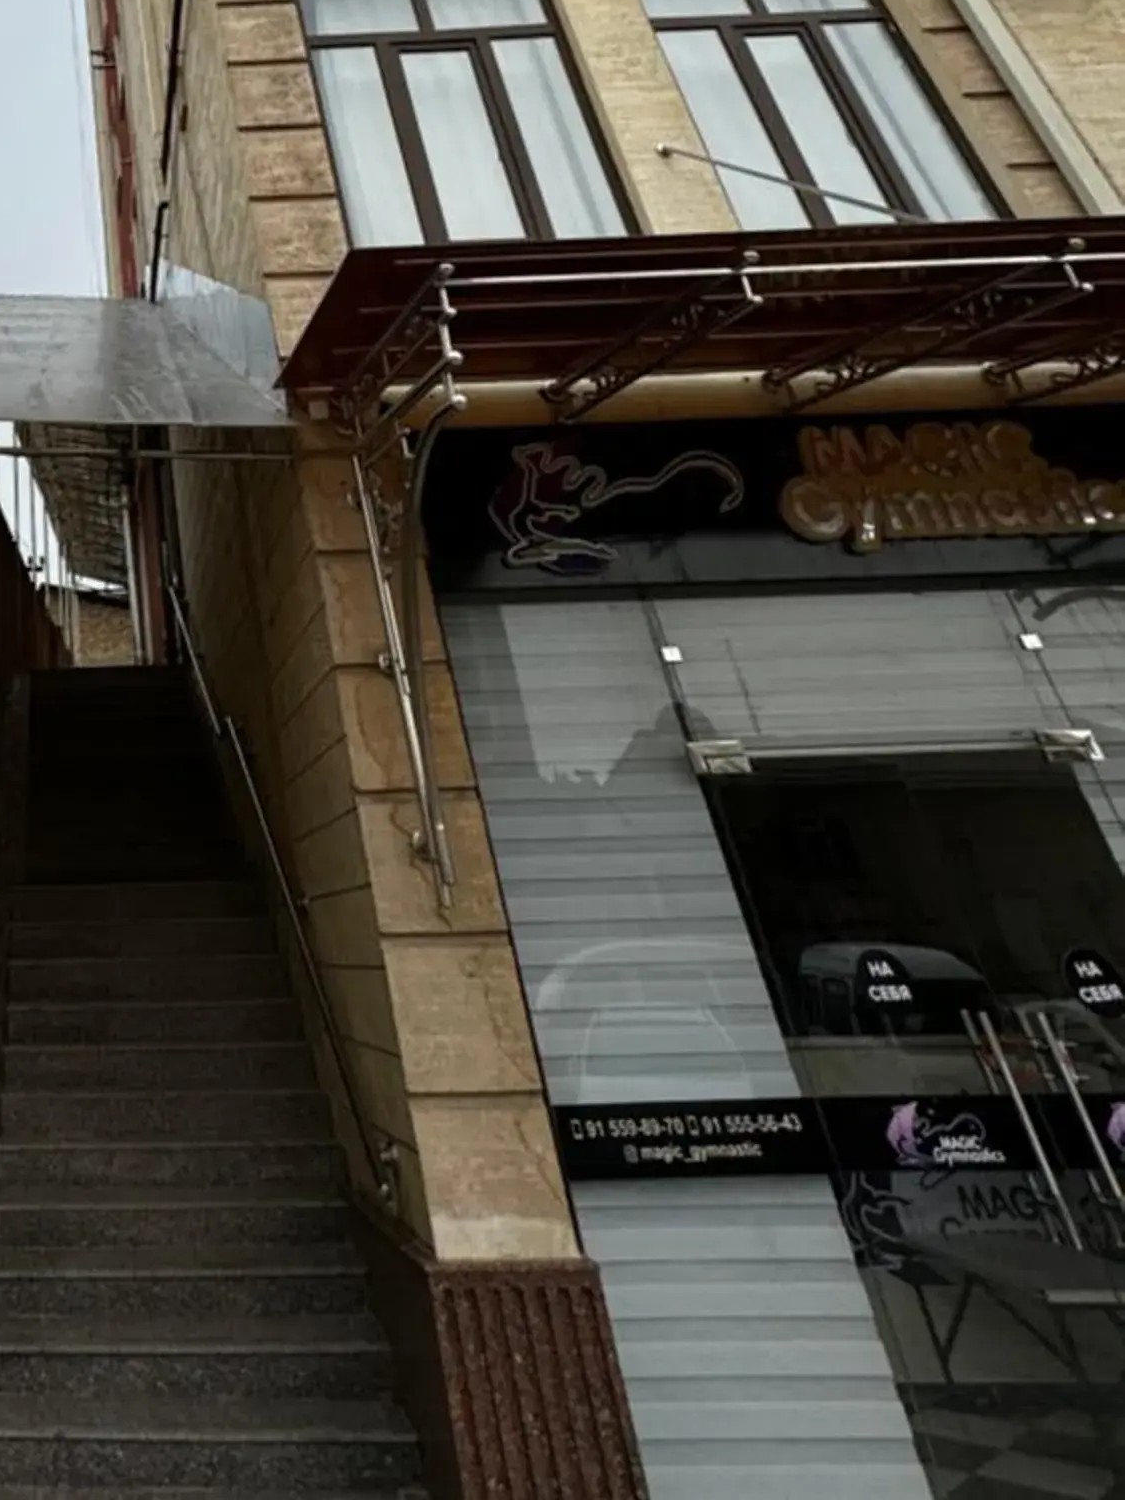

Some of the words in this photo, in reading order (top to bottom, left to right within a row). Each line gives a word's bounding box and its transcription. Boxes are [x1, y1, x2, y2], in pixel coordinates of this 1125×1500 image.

[799, 422, 1040, 480] MAGIC
[866, 960, 895, 978] НА
[867, 983, 913, 1002] СЕБЯ
[1078, 983, 1125, 1003] СЕБЯ
